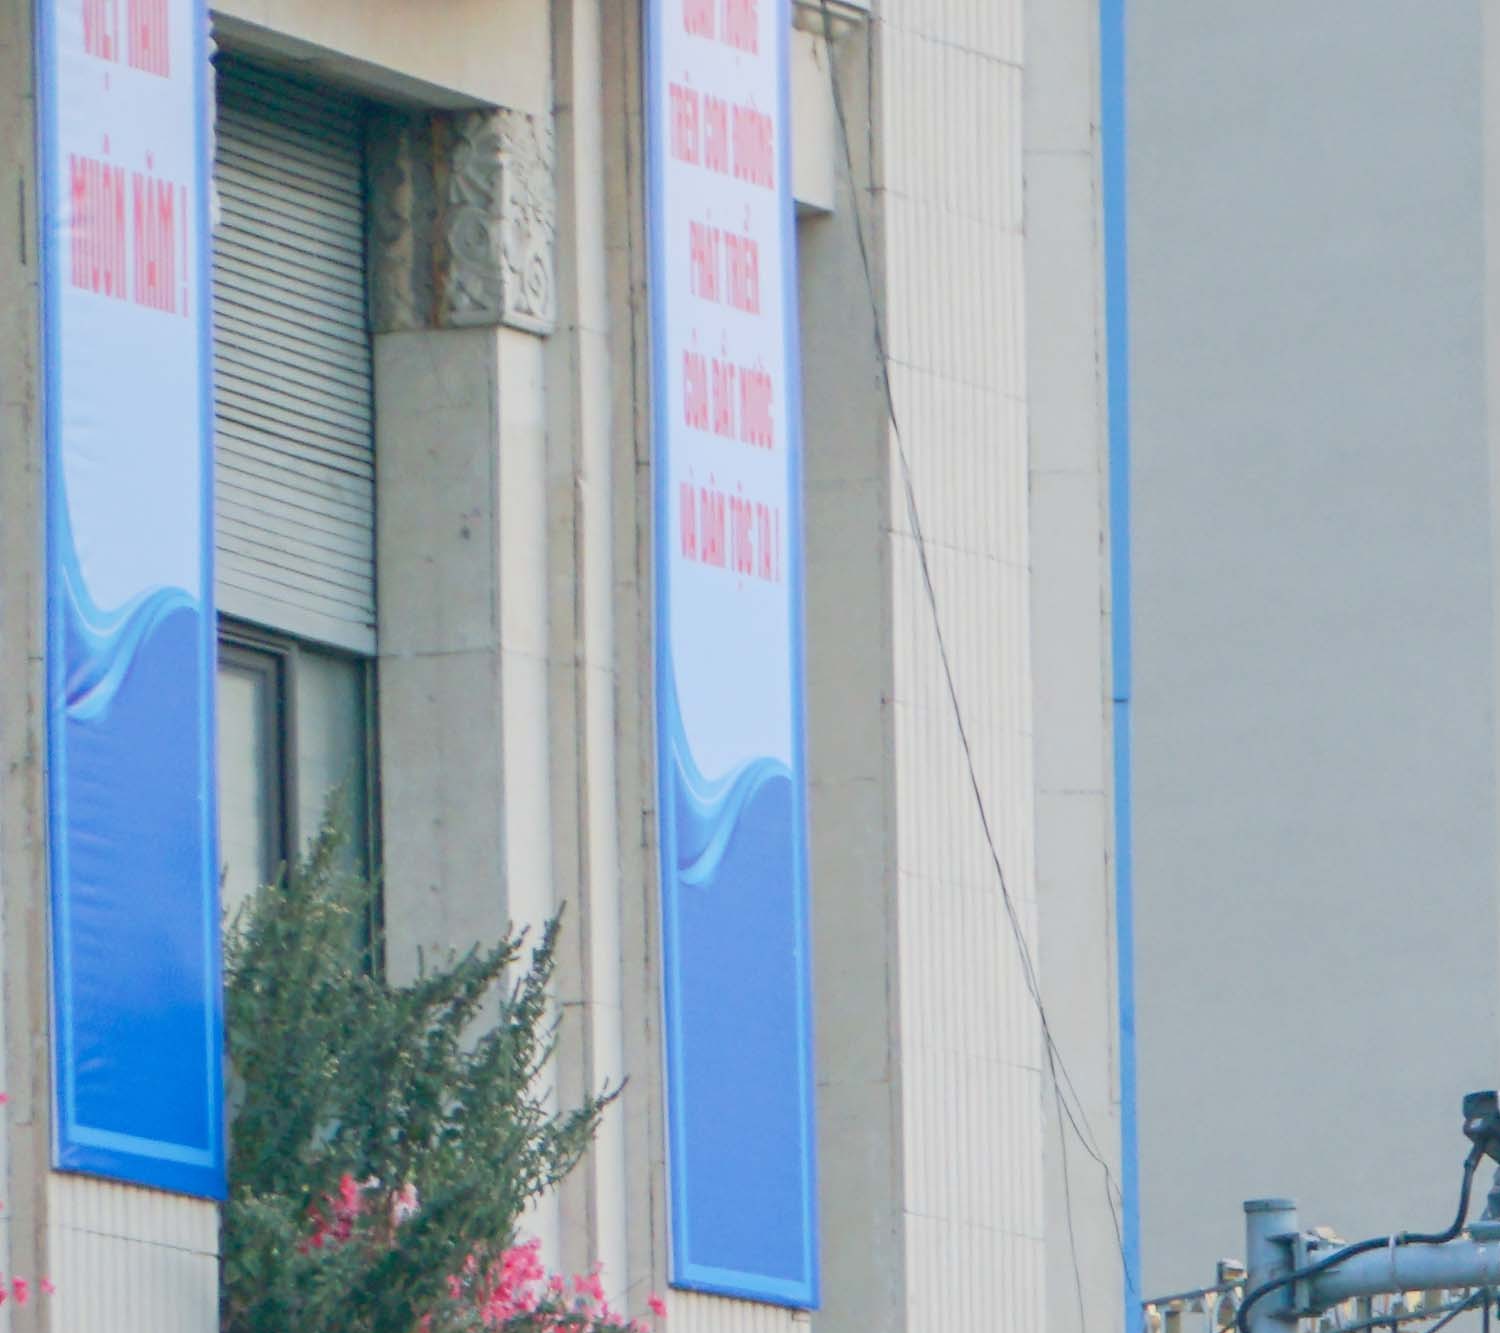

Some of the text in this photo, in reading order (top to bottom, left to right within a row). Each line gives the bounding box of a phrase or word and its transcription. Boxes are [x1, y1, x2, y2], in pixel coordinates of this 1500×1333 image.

[70, 133, 127, 301] MUÔN
[689, 203, 760, 315] PHÁT TRIỂN
[680, 464, 697, 560] VÀ
[701, 471, 726, 568] DÂN
